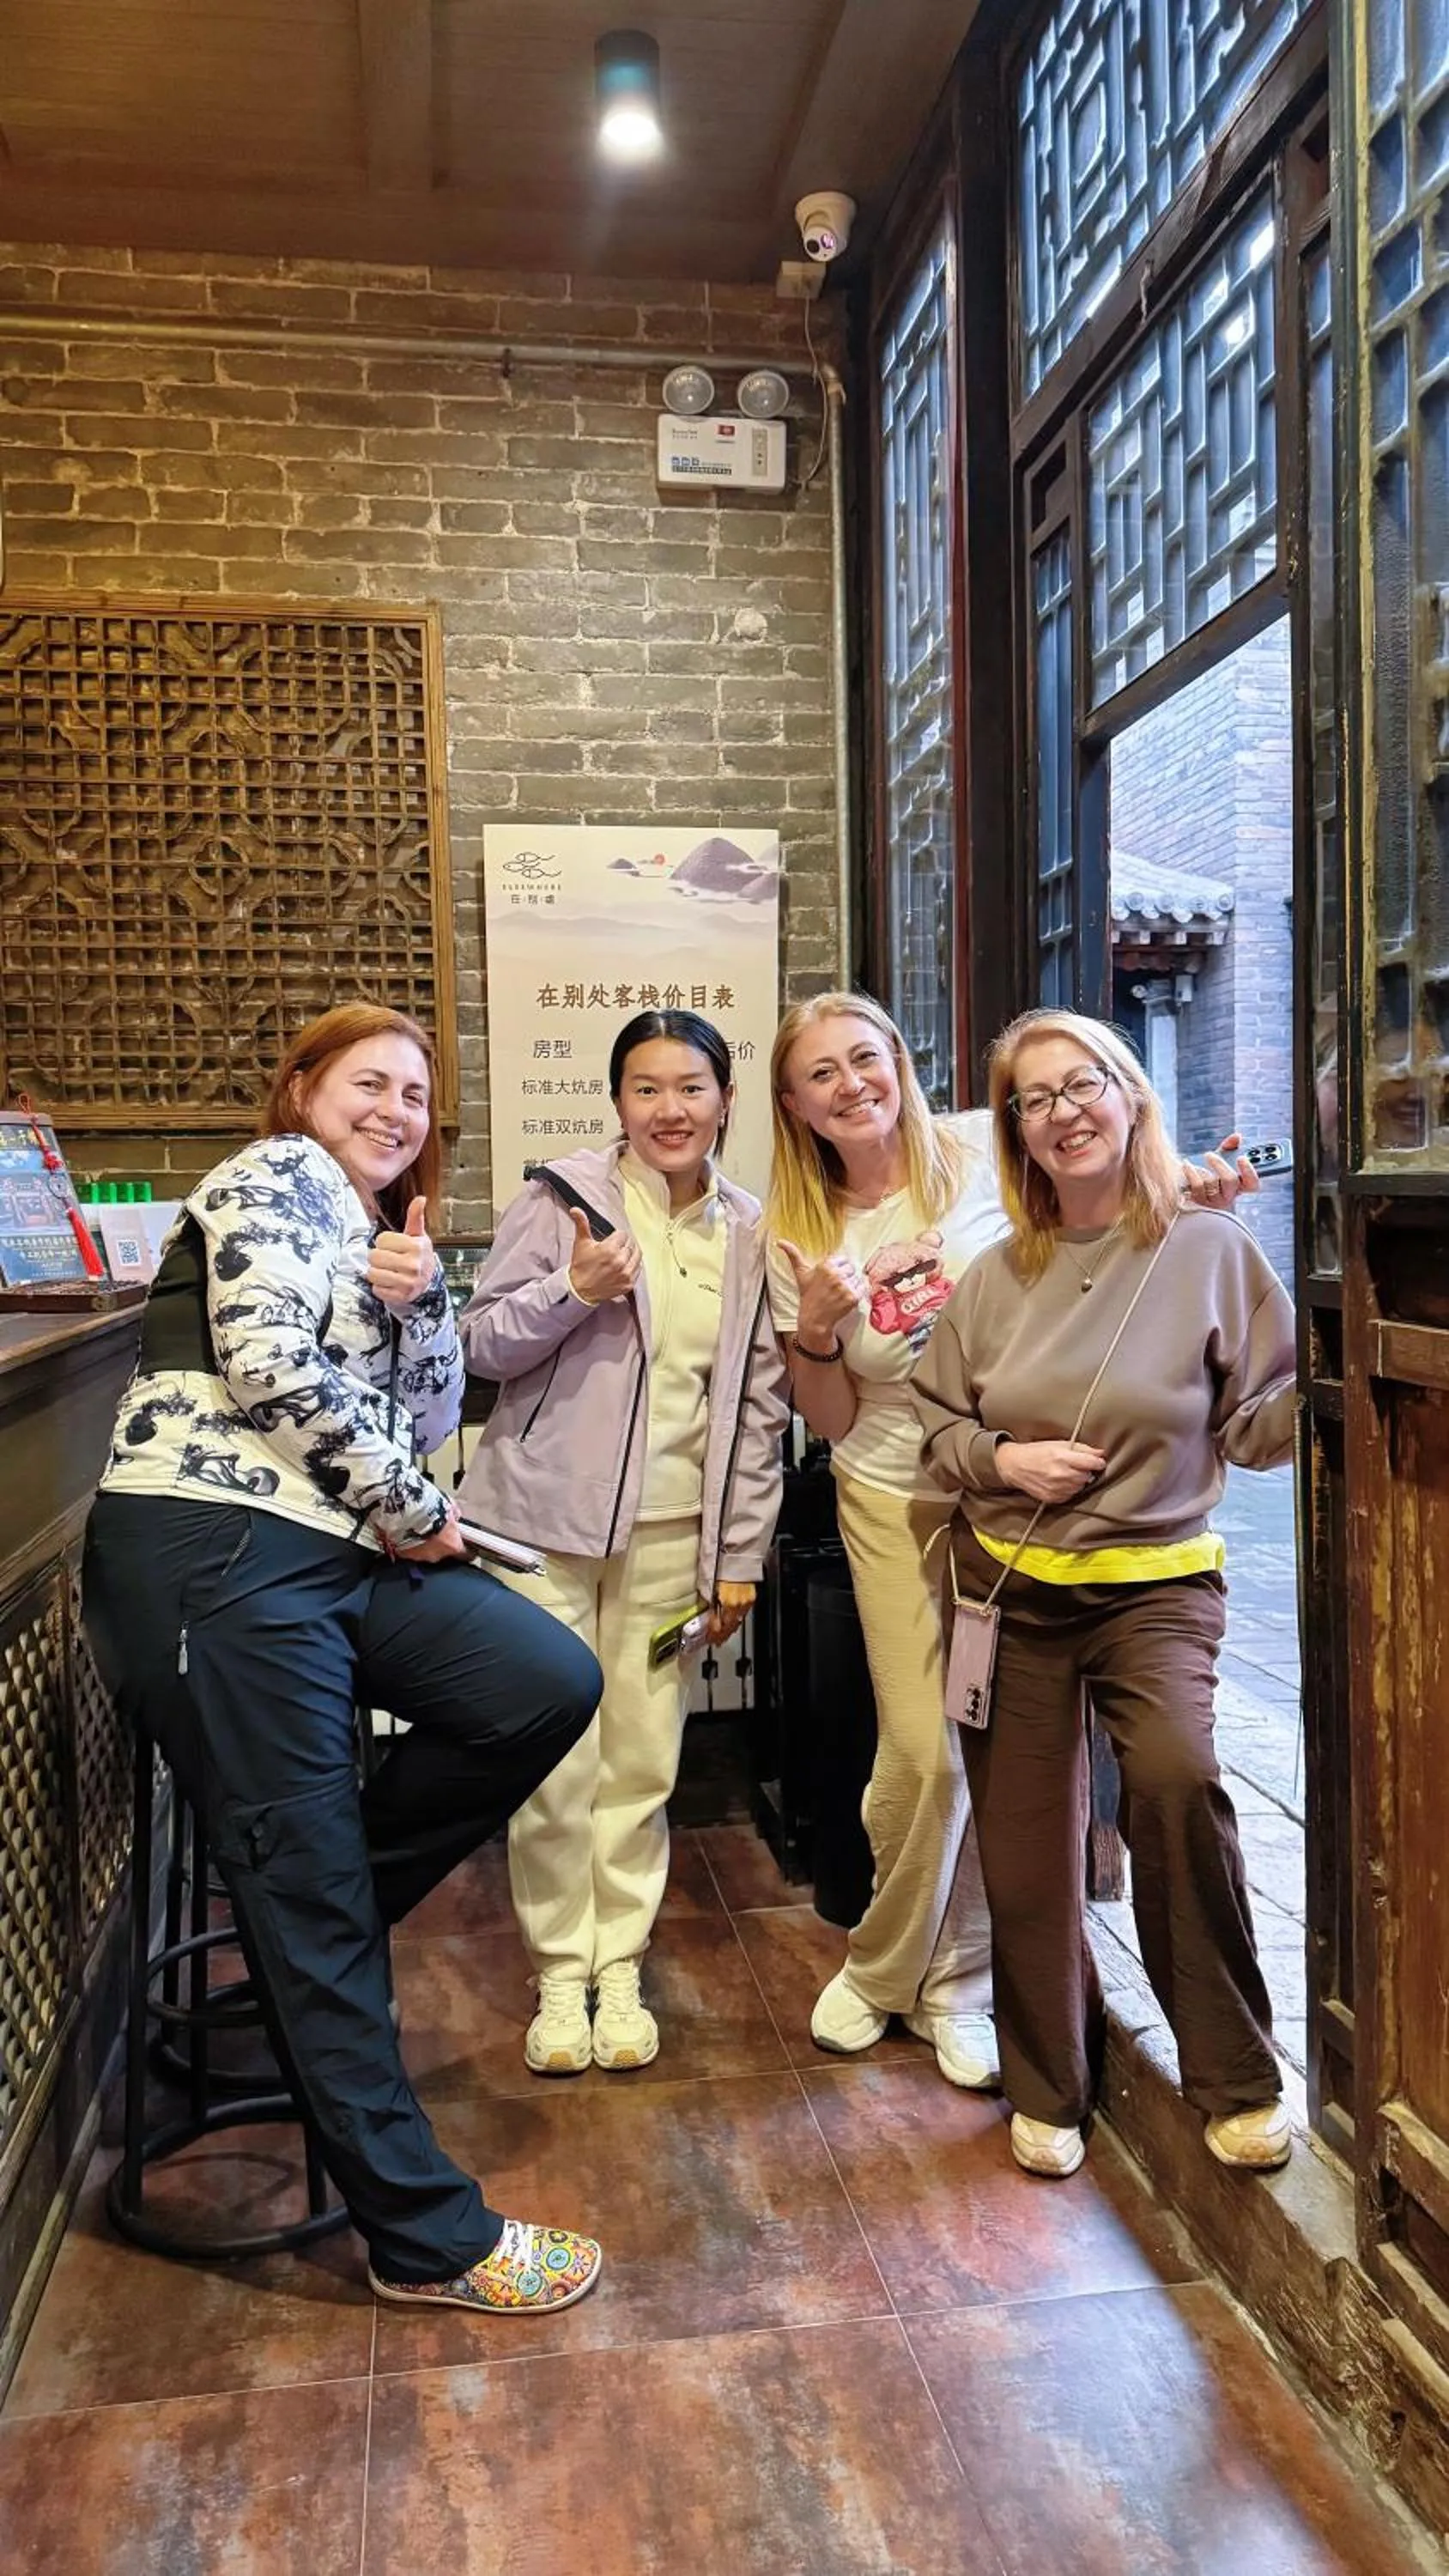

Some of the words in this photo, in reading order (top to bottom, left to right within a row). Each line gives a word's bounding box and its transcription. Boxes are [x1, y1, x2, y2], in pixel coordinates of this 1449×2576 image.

[536, 983, 736, 1009] 在别处客栈价目表
[533, 1040, 573, 1059] 房型
